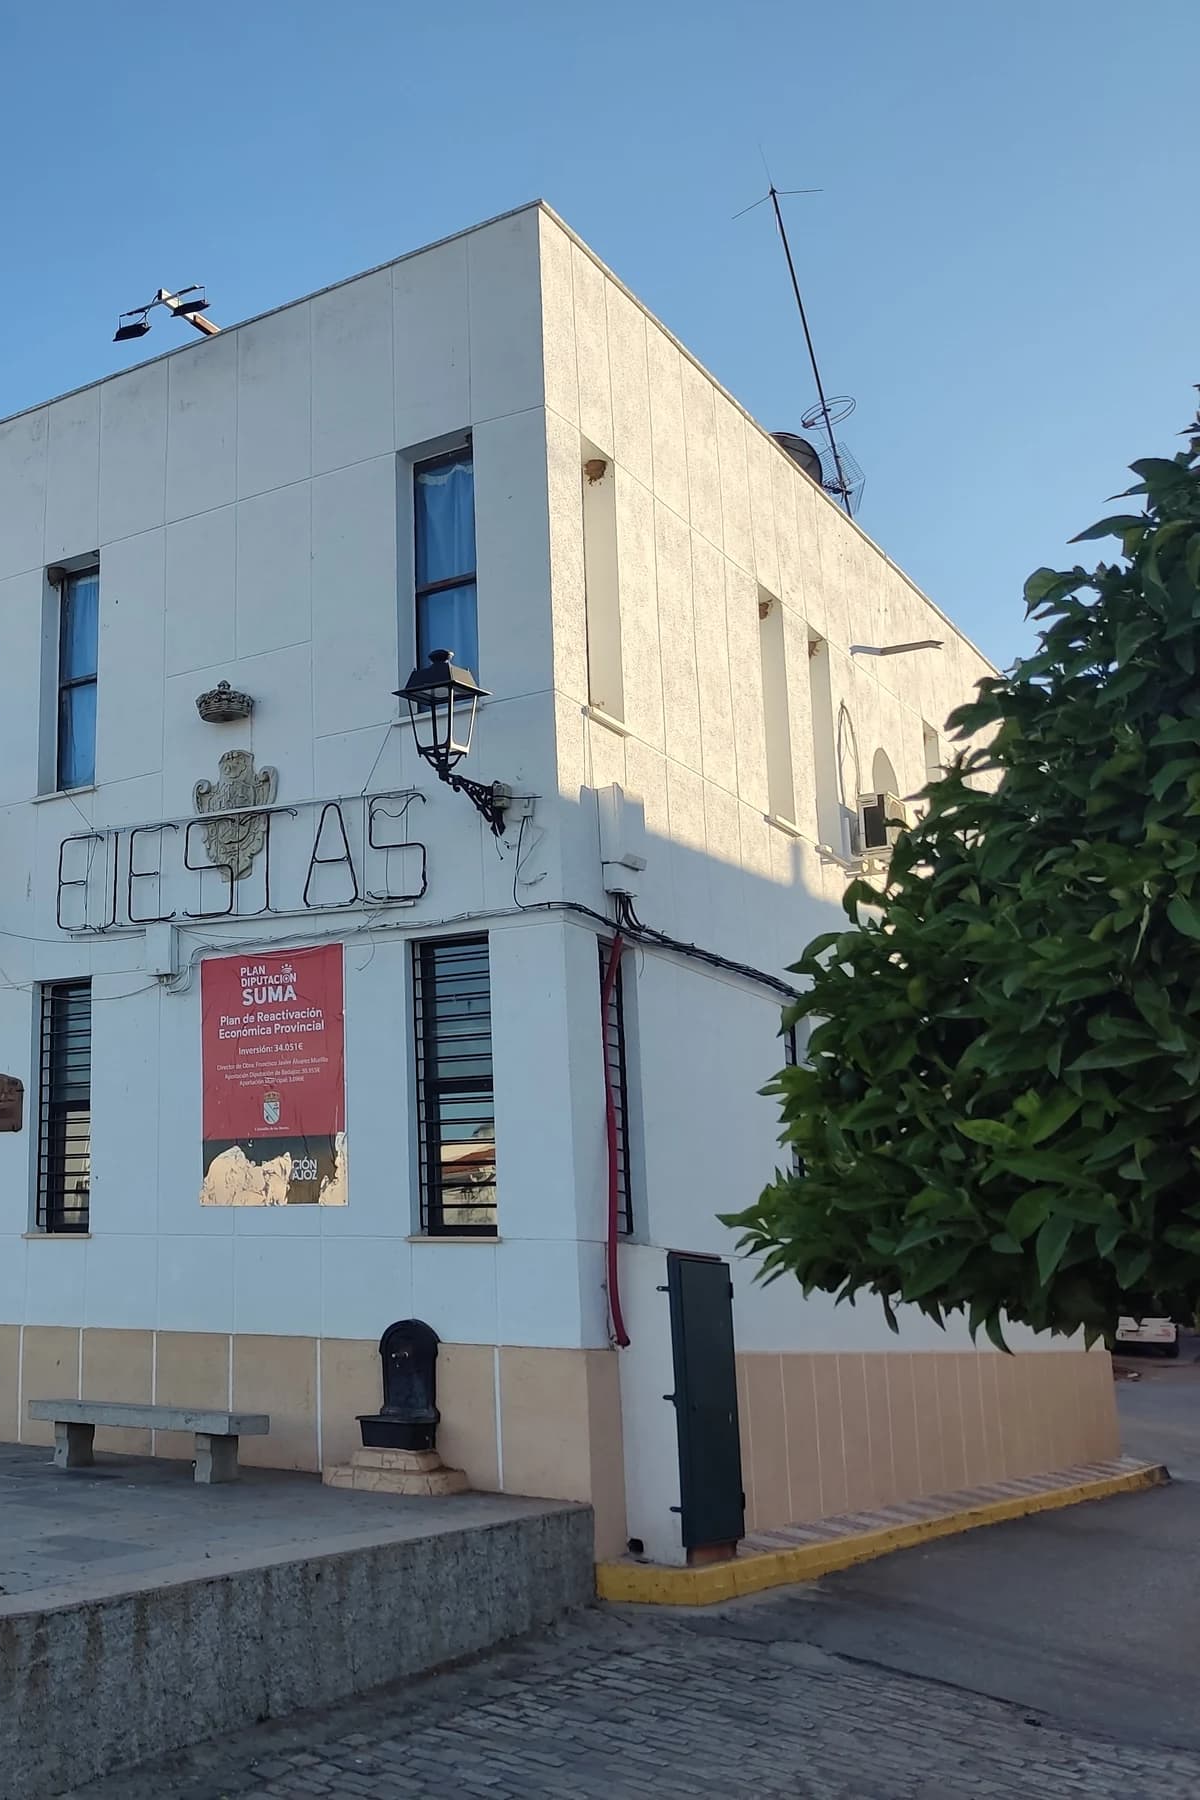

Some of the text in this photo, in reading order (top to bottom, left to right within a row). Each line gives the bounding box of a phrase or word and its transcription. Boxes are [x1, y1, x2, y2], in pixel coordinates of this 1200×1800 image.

[58, 794, 428, 931] FIESTAS
[240, 965, 266, 977] PLAN
[242, 985, 297, 1006] SUMA
[220, 1007, 322, 1026] Plan de Reactivación
[219, 1019, 325, 1040] Económica Provincial
[238, 1045, 273, 1056] Inversión:
[292, 1156, 317, 1170] CIÓN
[292, 1170, 317, 1180] AJOZ
